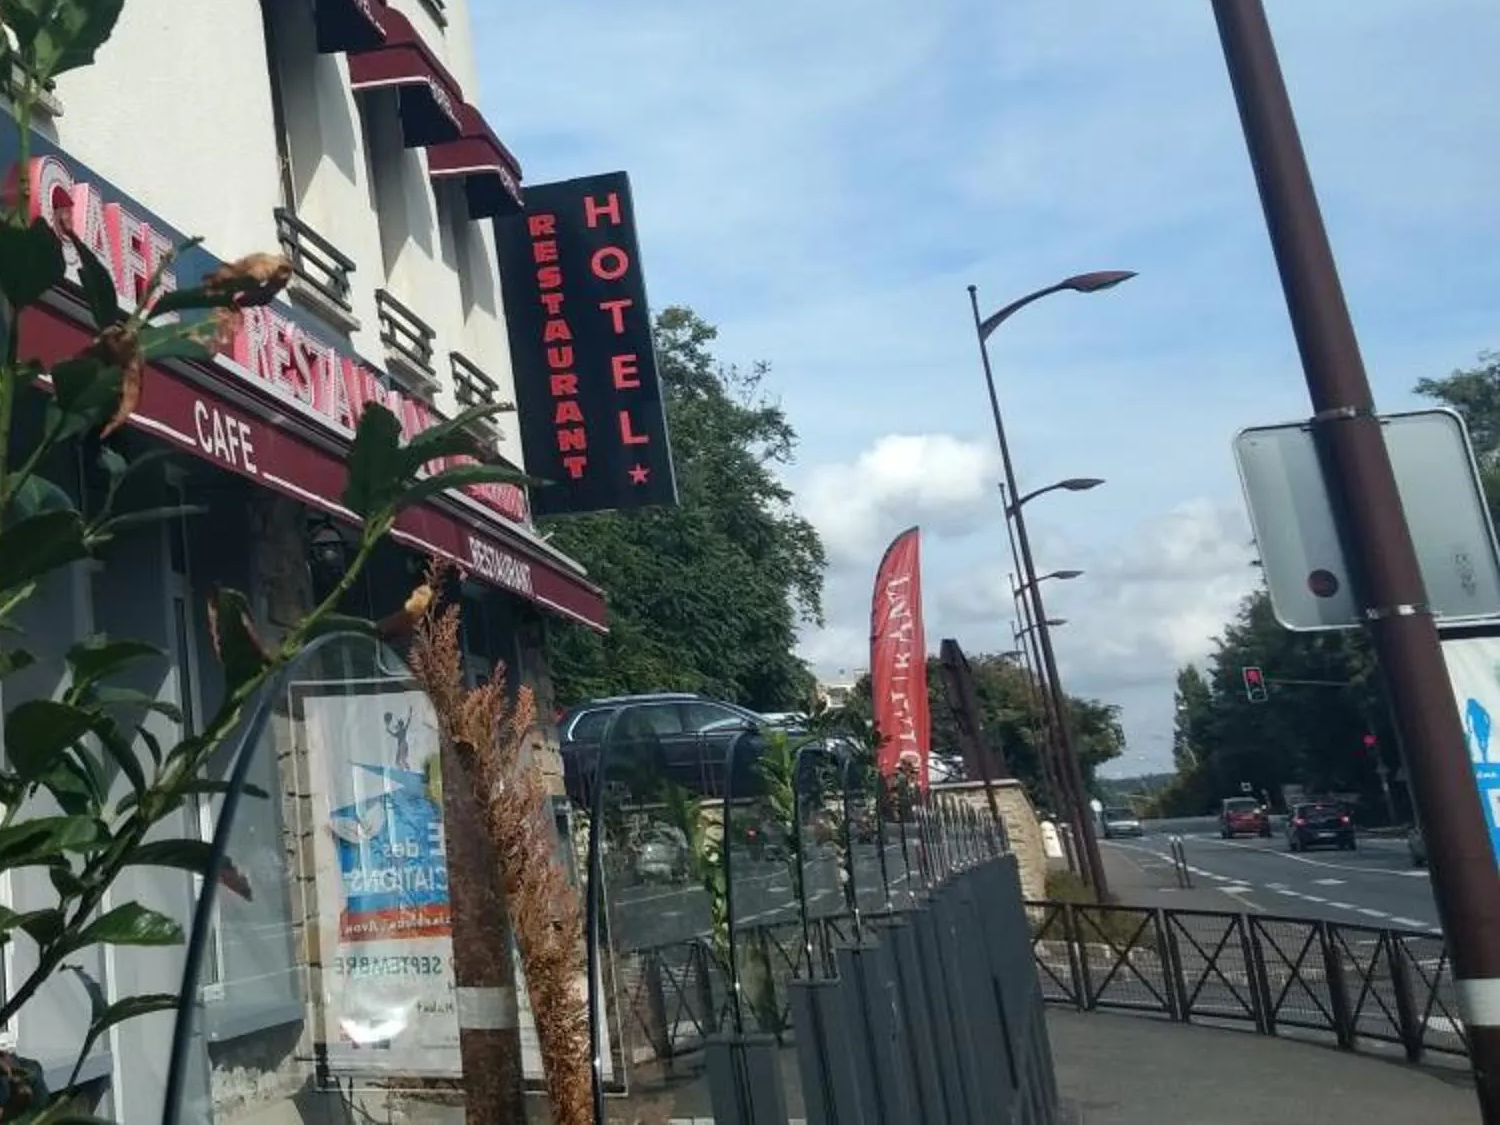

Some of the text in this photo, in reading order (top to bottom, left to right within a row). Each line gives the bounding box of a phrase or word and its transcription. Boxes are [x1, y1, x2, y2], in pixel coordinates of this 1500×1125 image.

[195, 399, 258, 474] CAFE
[528, 214, 588, 480] RESTAURANT
[584, 192, 649, 445] HOTEL
